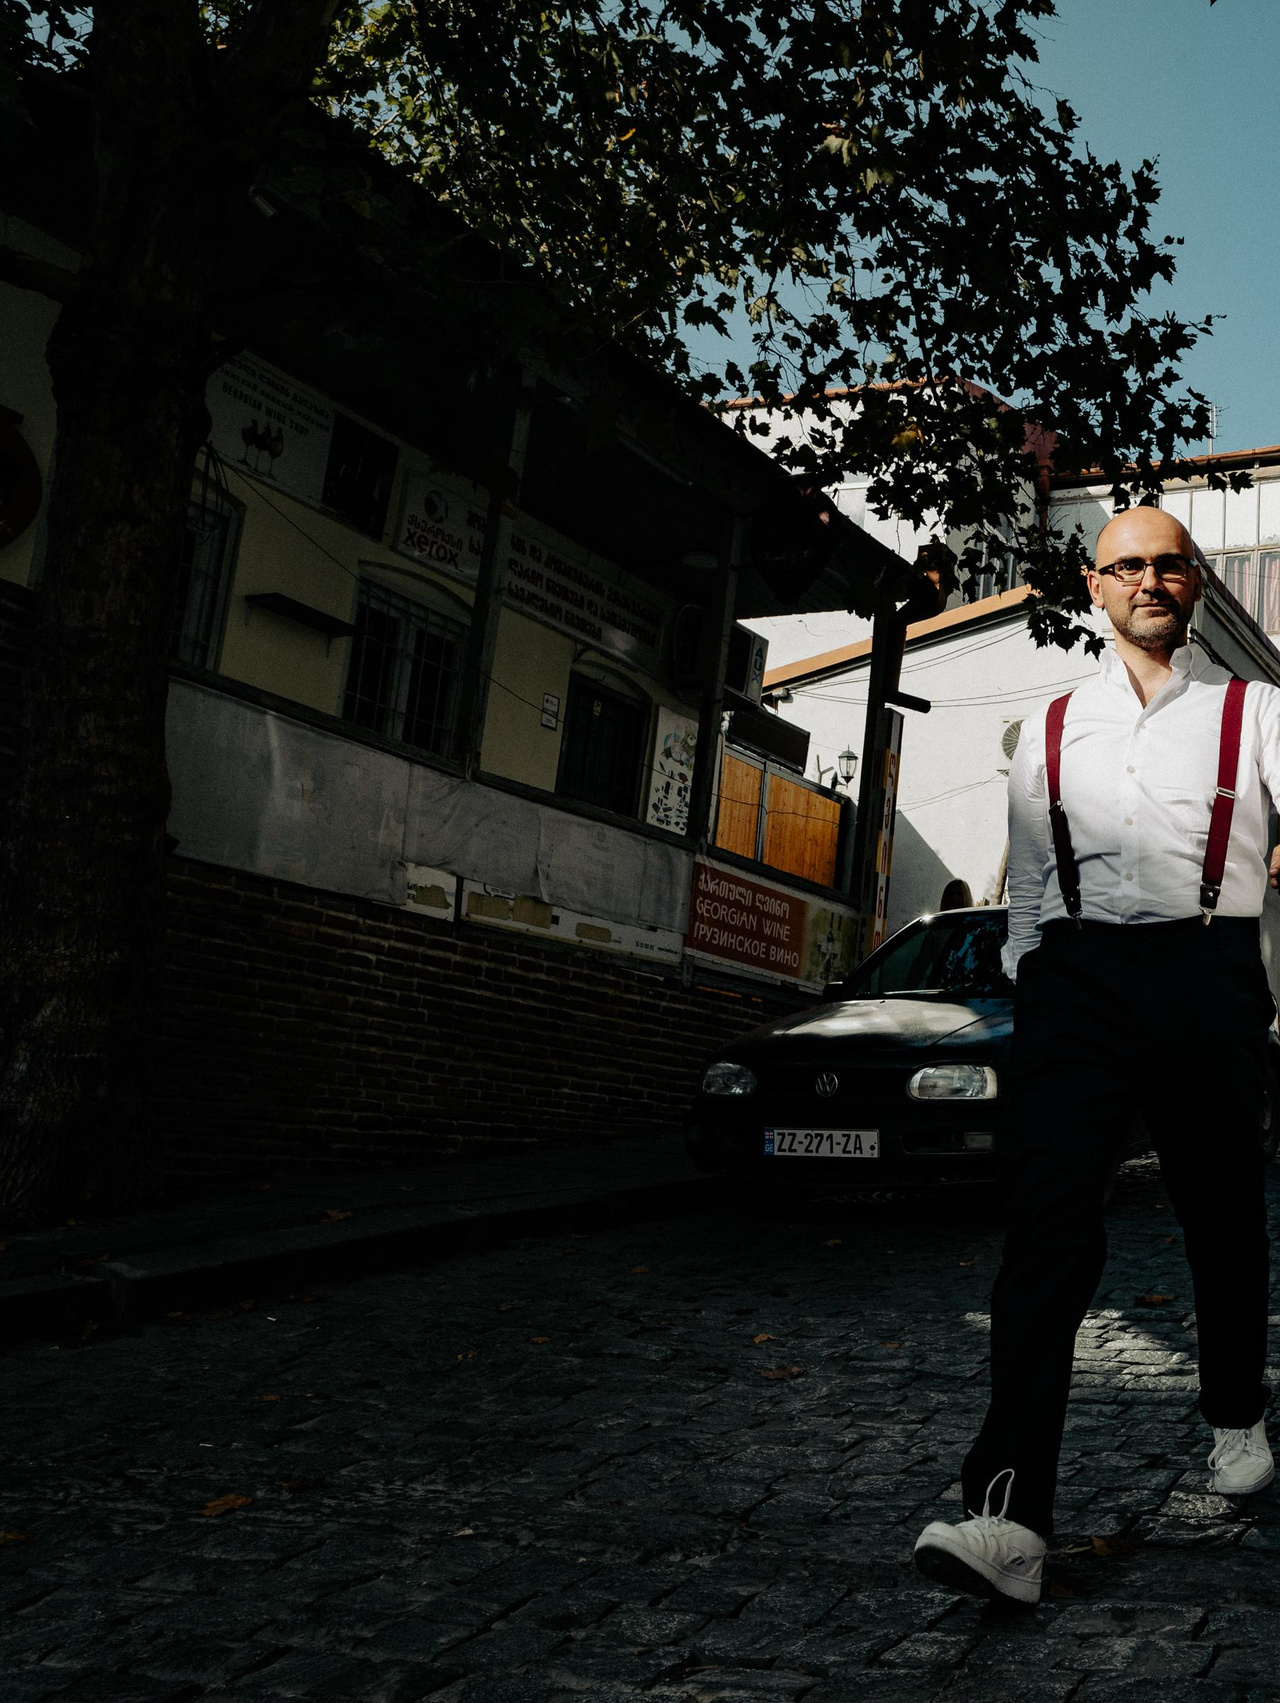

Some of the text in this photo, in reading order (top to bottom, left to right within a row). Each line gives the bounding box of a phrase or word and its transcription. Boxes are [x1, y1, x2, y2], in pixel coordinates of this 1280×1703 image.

[222, 381, 310, 437] GEORGIAN WINE SHOP
[407, 513, 464, 552] ქსეროქსი
[752, 647, 764, 683] AUX
[698, 872, 790, 919] ქართული ღვინო
[696, 897, 791, 942] GEORGIAN WINE
[693, 921, 800, 968] ГРУЗИНСКОЕ ВИНО
[764, 1131, 864, 1155] GE ZZ-271-ZA
